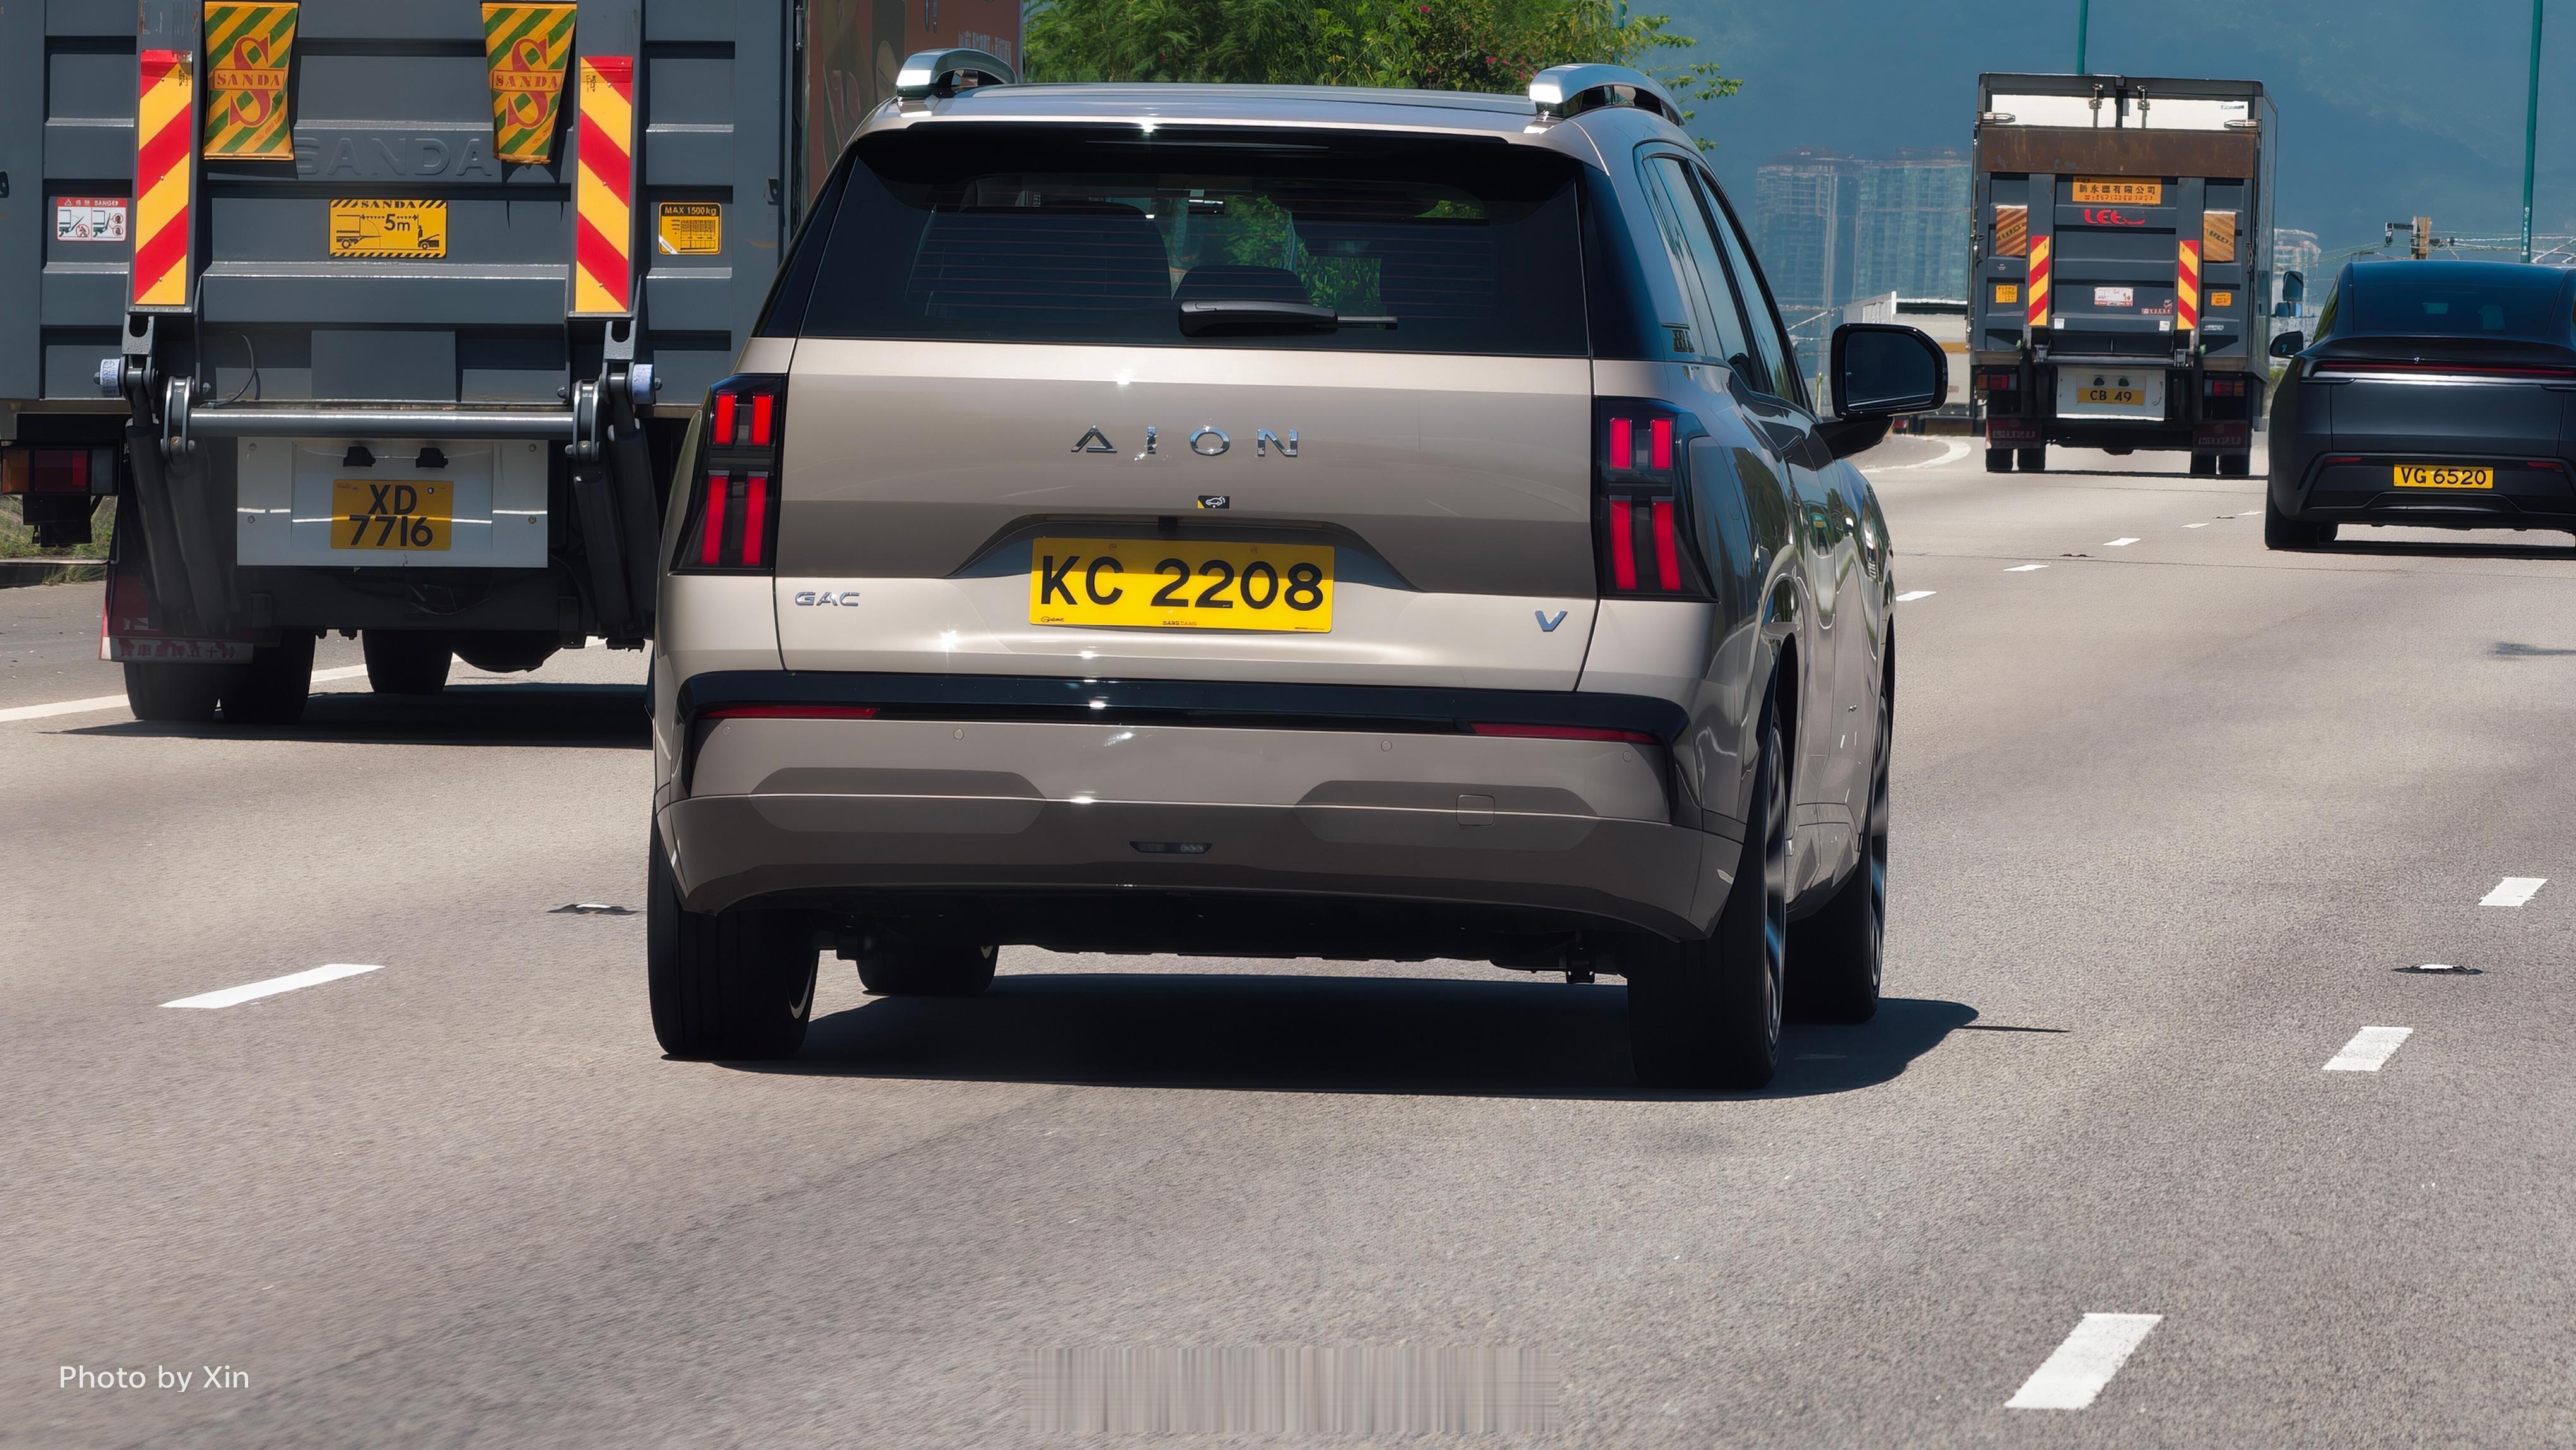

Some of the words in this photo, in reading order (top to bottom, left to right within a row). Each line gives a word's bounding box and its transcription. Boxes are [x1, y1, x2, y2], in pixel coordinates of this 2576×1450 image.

[217, 73, 280, 87] SANDA
[495, 75, 558, 88] SANDA
[361, 200, 415, 208] SANDA
[384, 213, 410, 231] 5m
[2090, 390, 2107, 400] CB
[2114, 391, 2132, 402] 49
[1071, 426, 1298, 458] AION
[2401, 467, 2426, 484] VG
[2433, 468, 2486, 485] 6520
[367, 484, 417, 515] XD
[349, 515, 433, 547] 7716
[1041, 555, 1124, 606] KC
[1150, 558, 1324, 611] 2208
[795, 591, 861, 607] GAC
[1534, 610, 1568, 632] V
